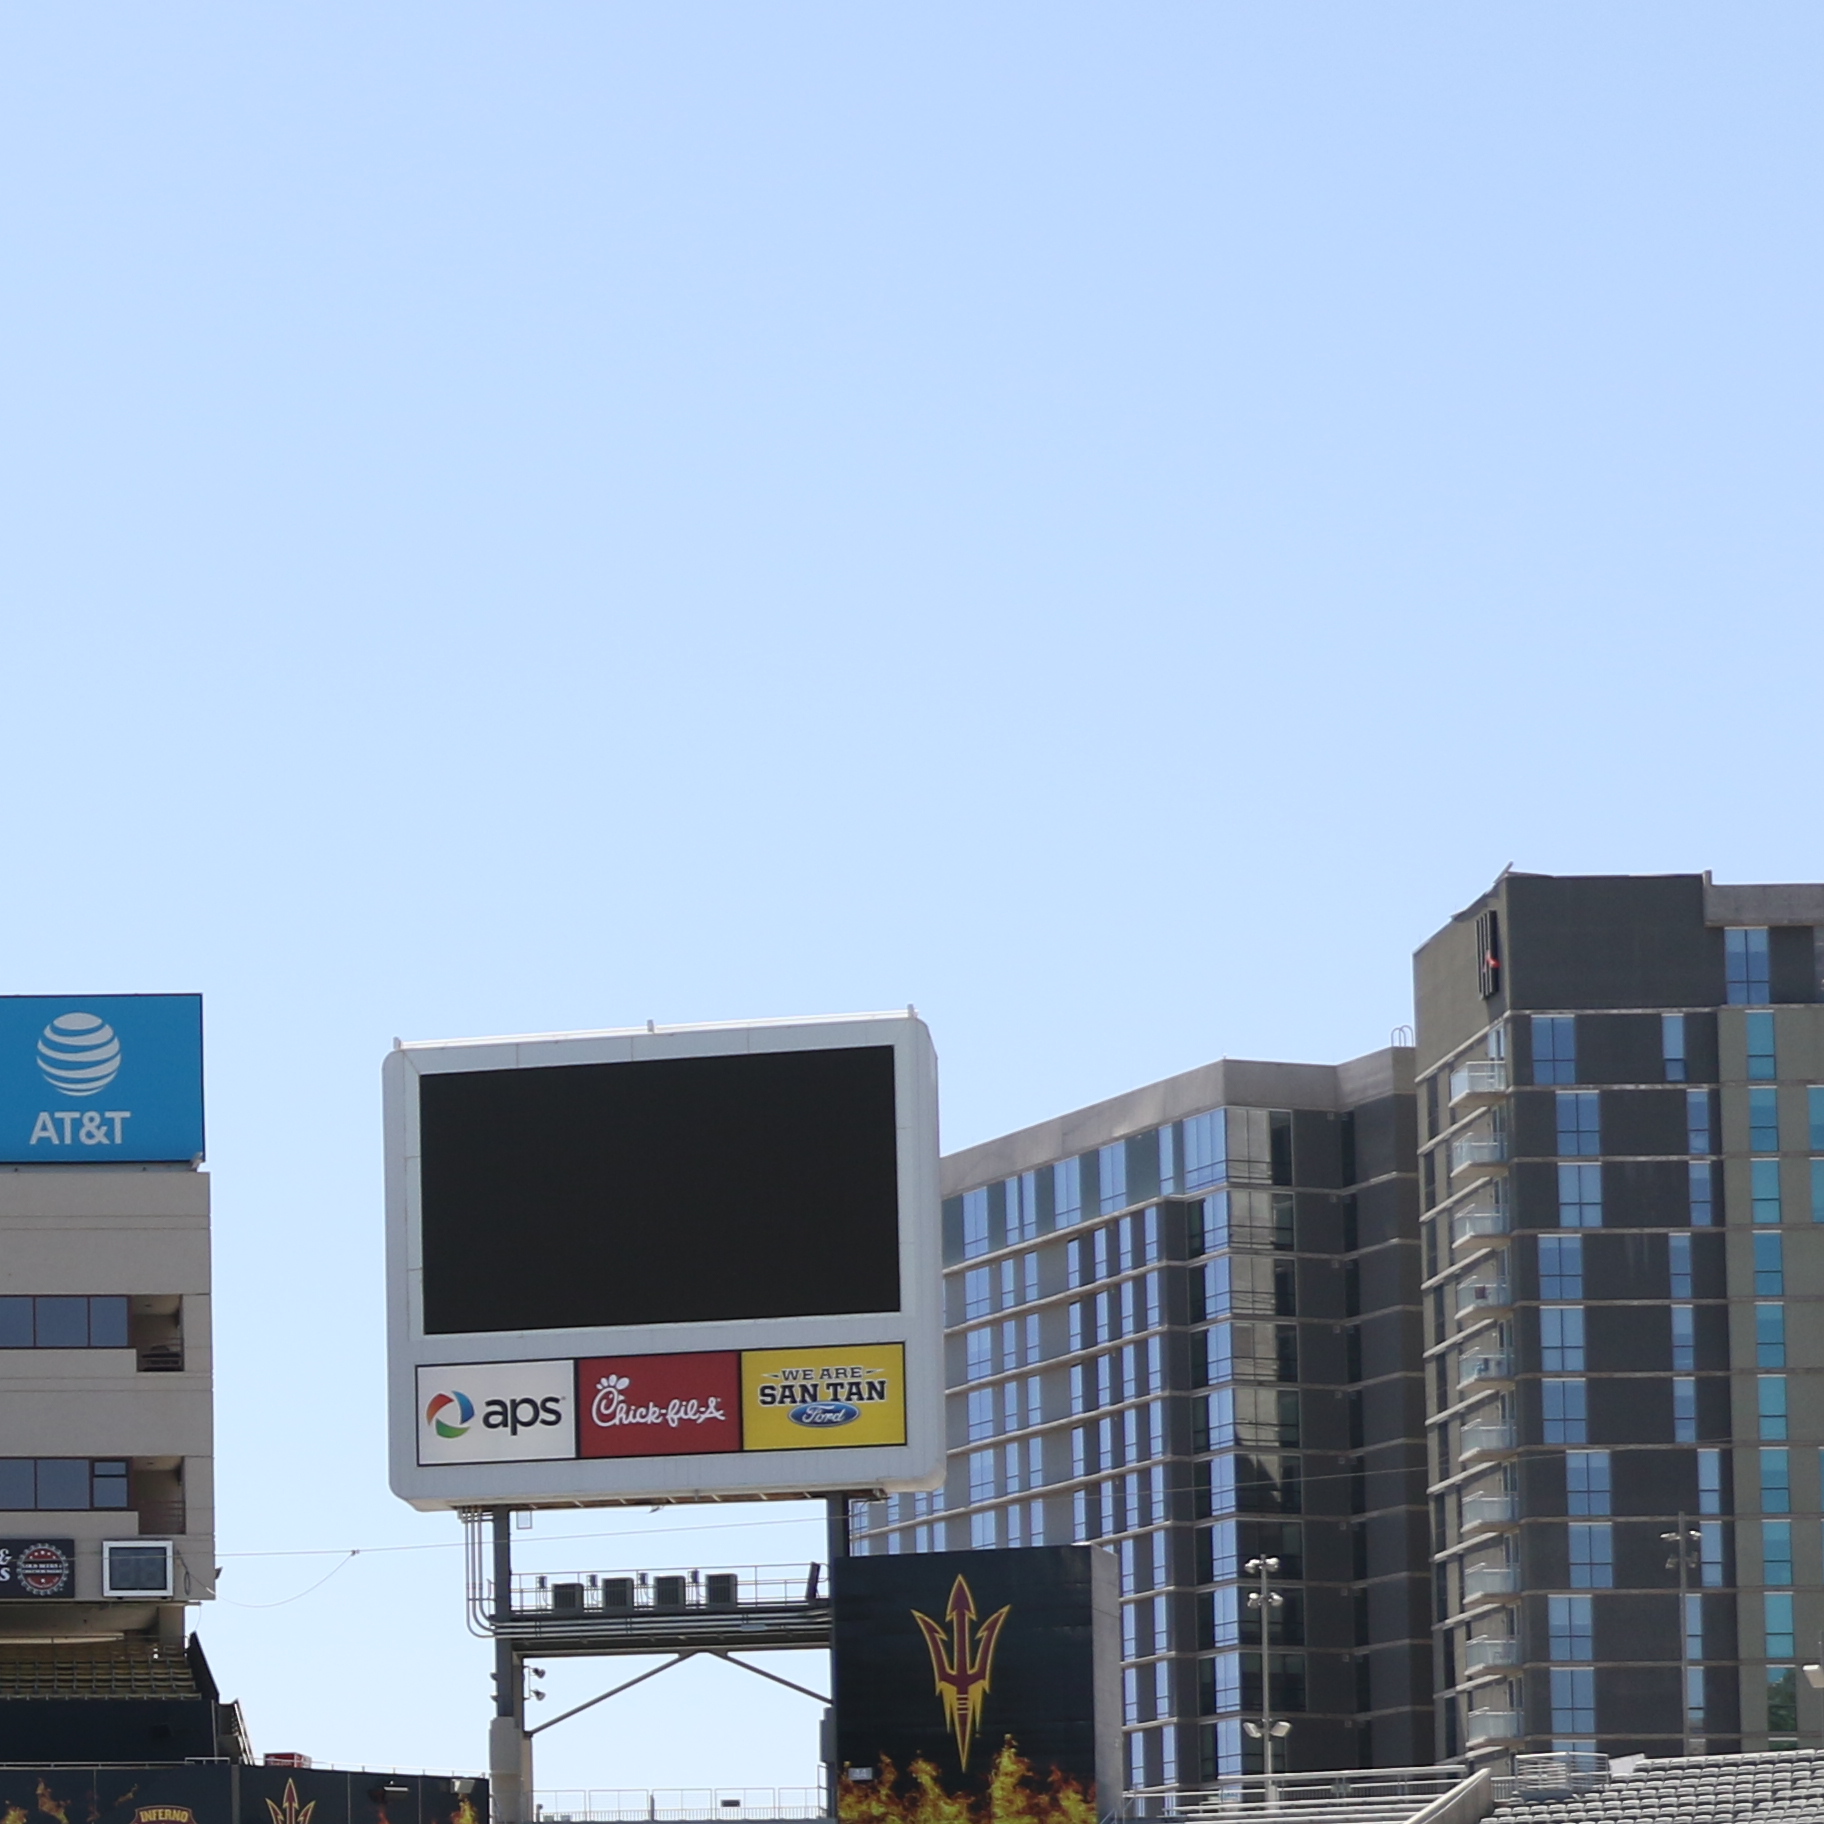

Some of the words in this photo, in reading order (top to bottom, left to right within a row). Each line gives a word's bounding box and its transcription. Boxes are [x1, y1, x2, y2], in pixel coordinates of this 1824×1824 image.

[29, 1110, 131, 1146] AT&T
[781, 1368, 814, 1381] WE
[819, 1367, 863, 1380] ARE
[759, 1383, 819, 1405] SAN
[826, 1380, 886, 1401] TAN
[482, 1396, 562, 1436] aps
[592, 1384, 725, 1427] Chick-fil-A
[803, 1405, 846, 1423] Ford
[139, 1808, 189, 1823] INFERNO
